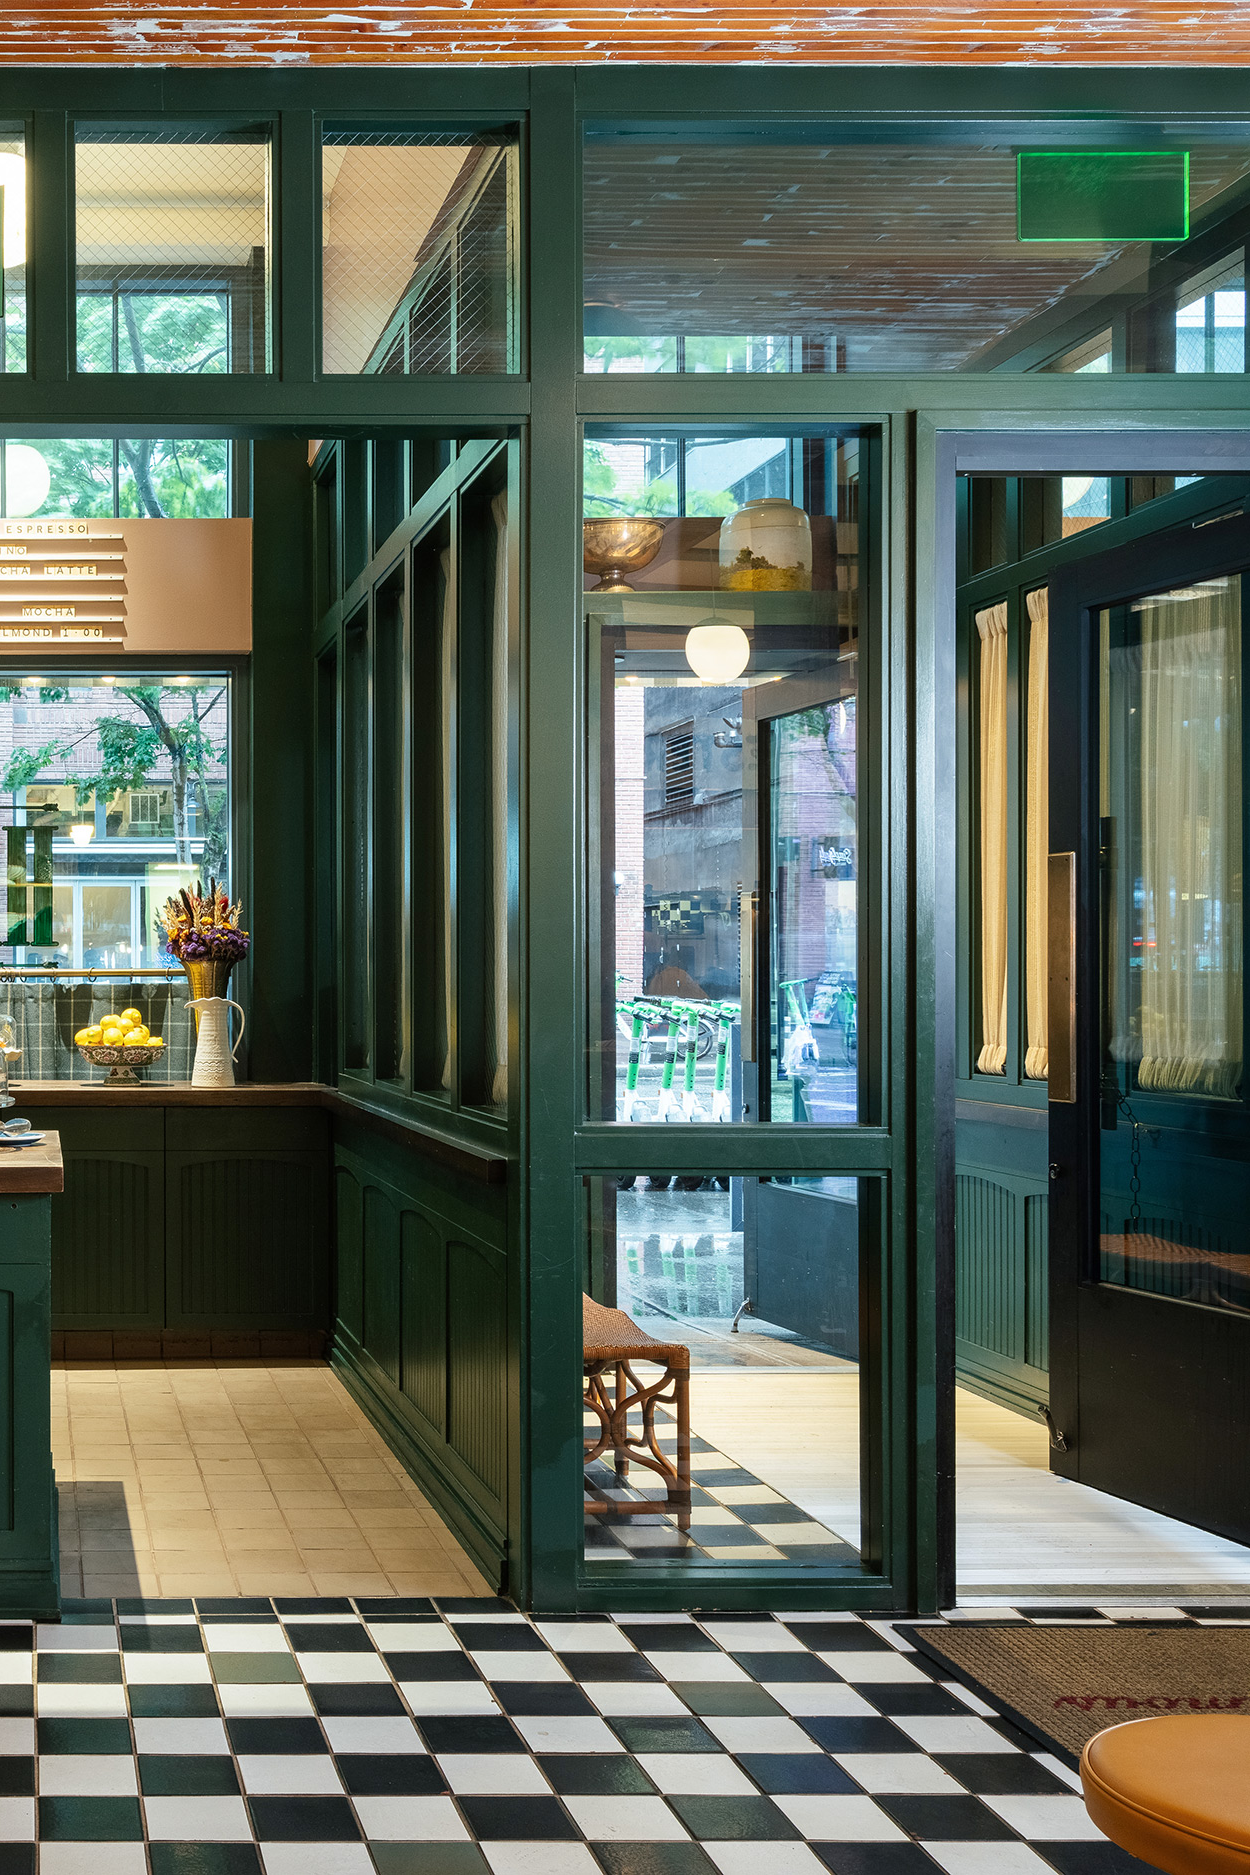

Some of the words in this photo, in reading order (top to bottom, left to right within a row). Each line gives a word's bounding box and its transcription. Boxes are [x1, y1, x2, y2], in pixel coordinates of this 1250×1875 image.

[6, 524, 87, 534] ESPRESSO
[46, 566, 95, 575] LATTE
[23, 608, 74, 616] MOCHA
